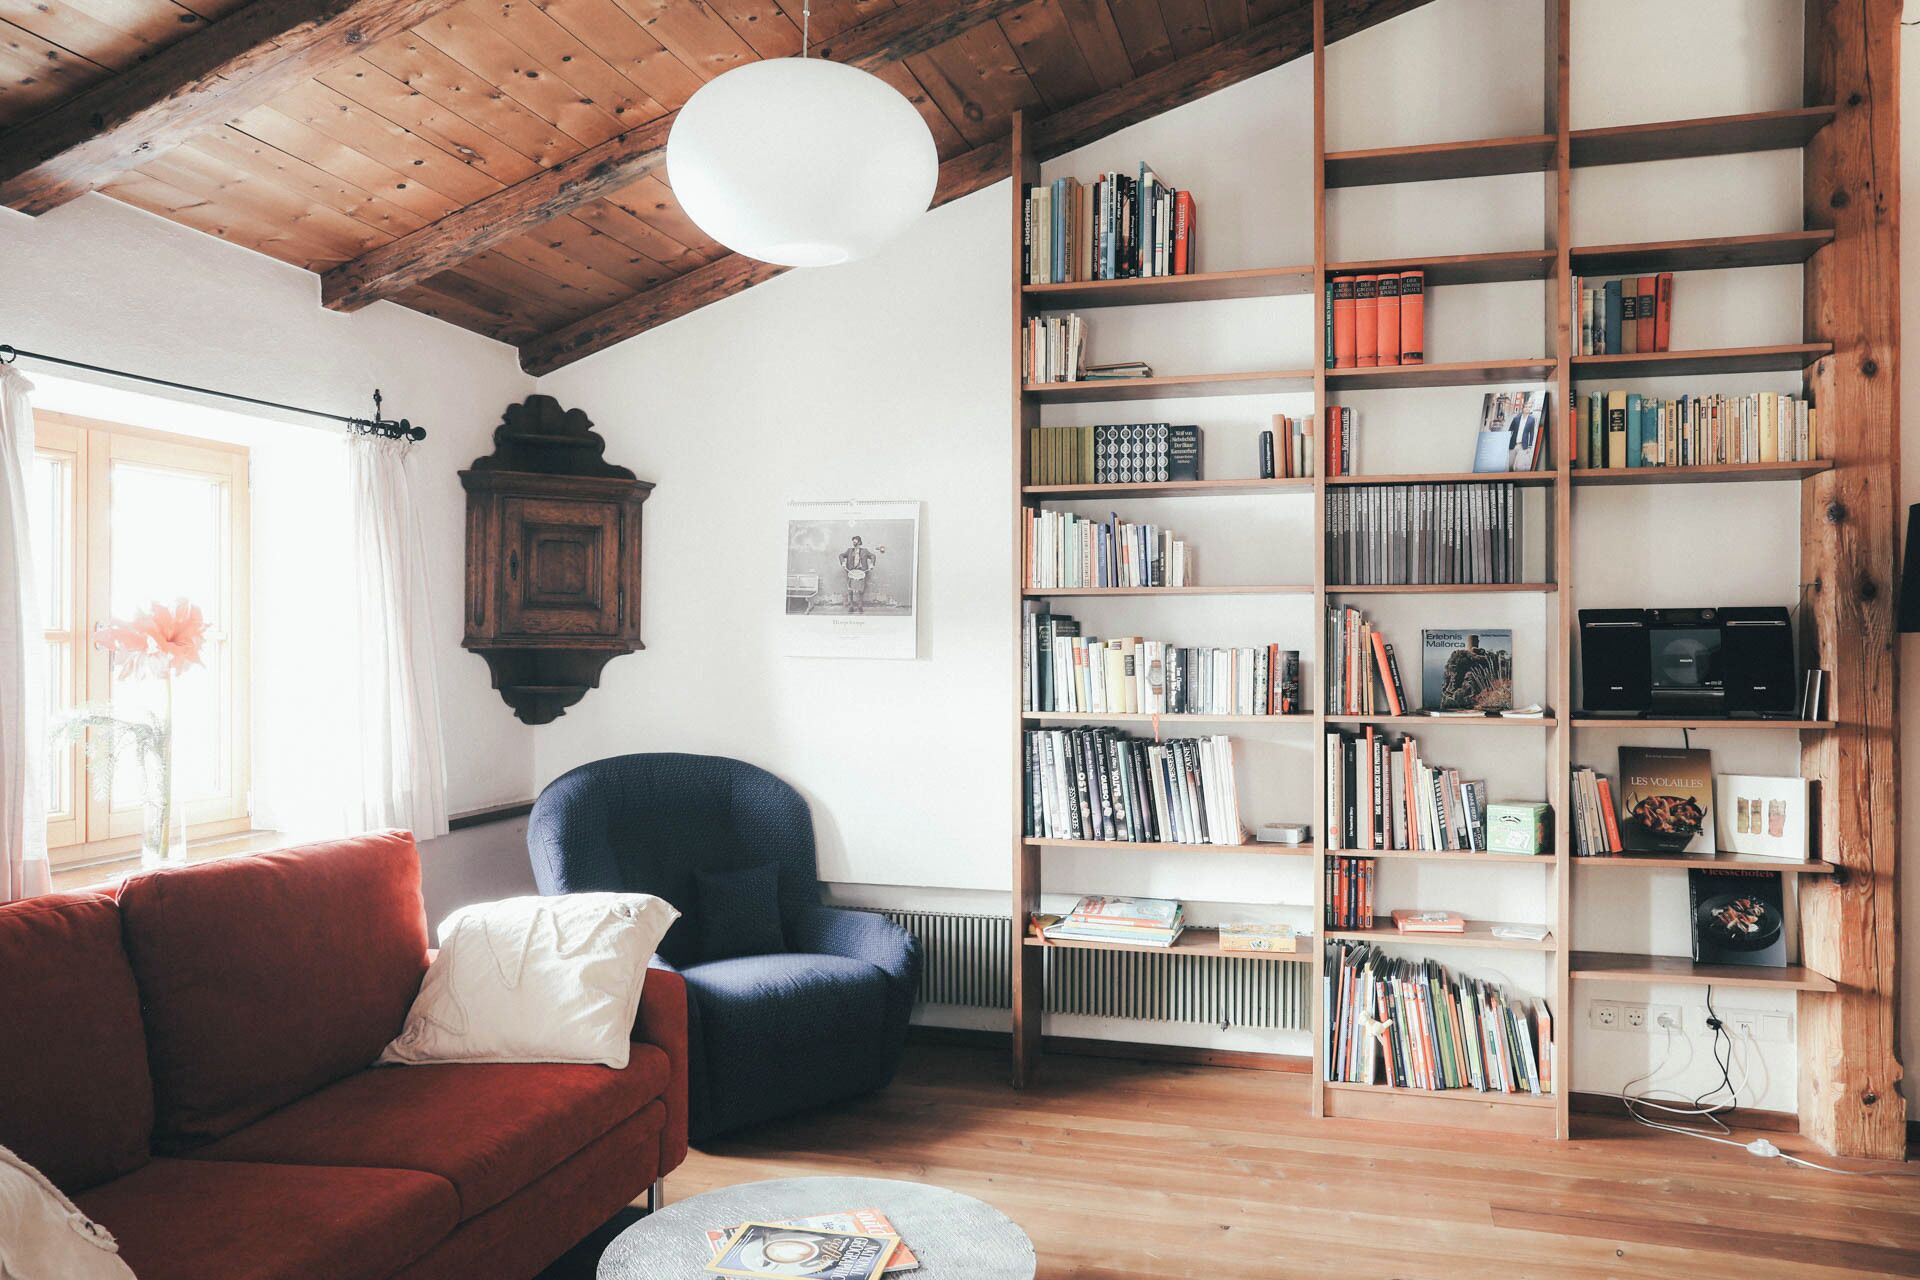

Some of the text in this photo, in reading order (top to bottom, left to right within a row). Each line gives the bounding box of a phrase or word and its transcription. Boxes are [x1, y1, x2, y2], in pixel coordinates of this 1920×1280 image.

[1426, 640, 1466, 648] Mallorca
[1167, 749, 1177, 781] DESSERT
[1183, 746, 1193, 772] CARNE
[1077, 772, 1087, 793] OST
[1100, 774, 1109, 800] QUESO
[1111, 770, 1121, 797] SAJTOK
[1631, 776, 1703, 788] LES VOLAILLES
[831, 1237, 869, 1280] GEOGRAPHIC
[849, 1244, 880, 1275] NATIONAL
